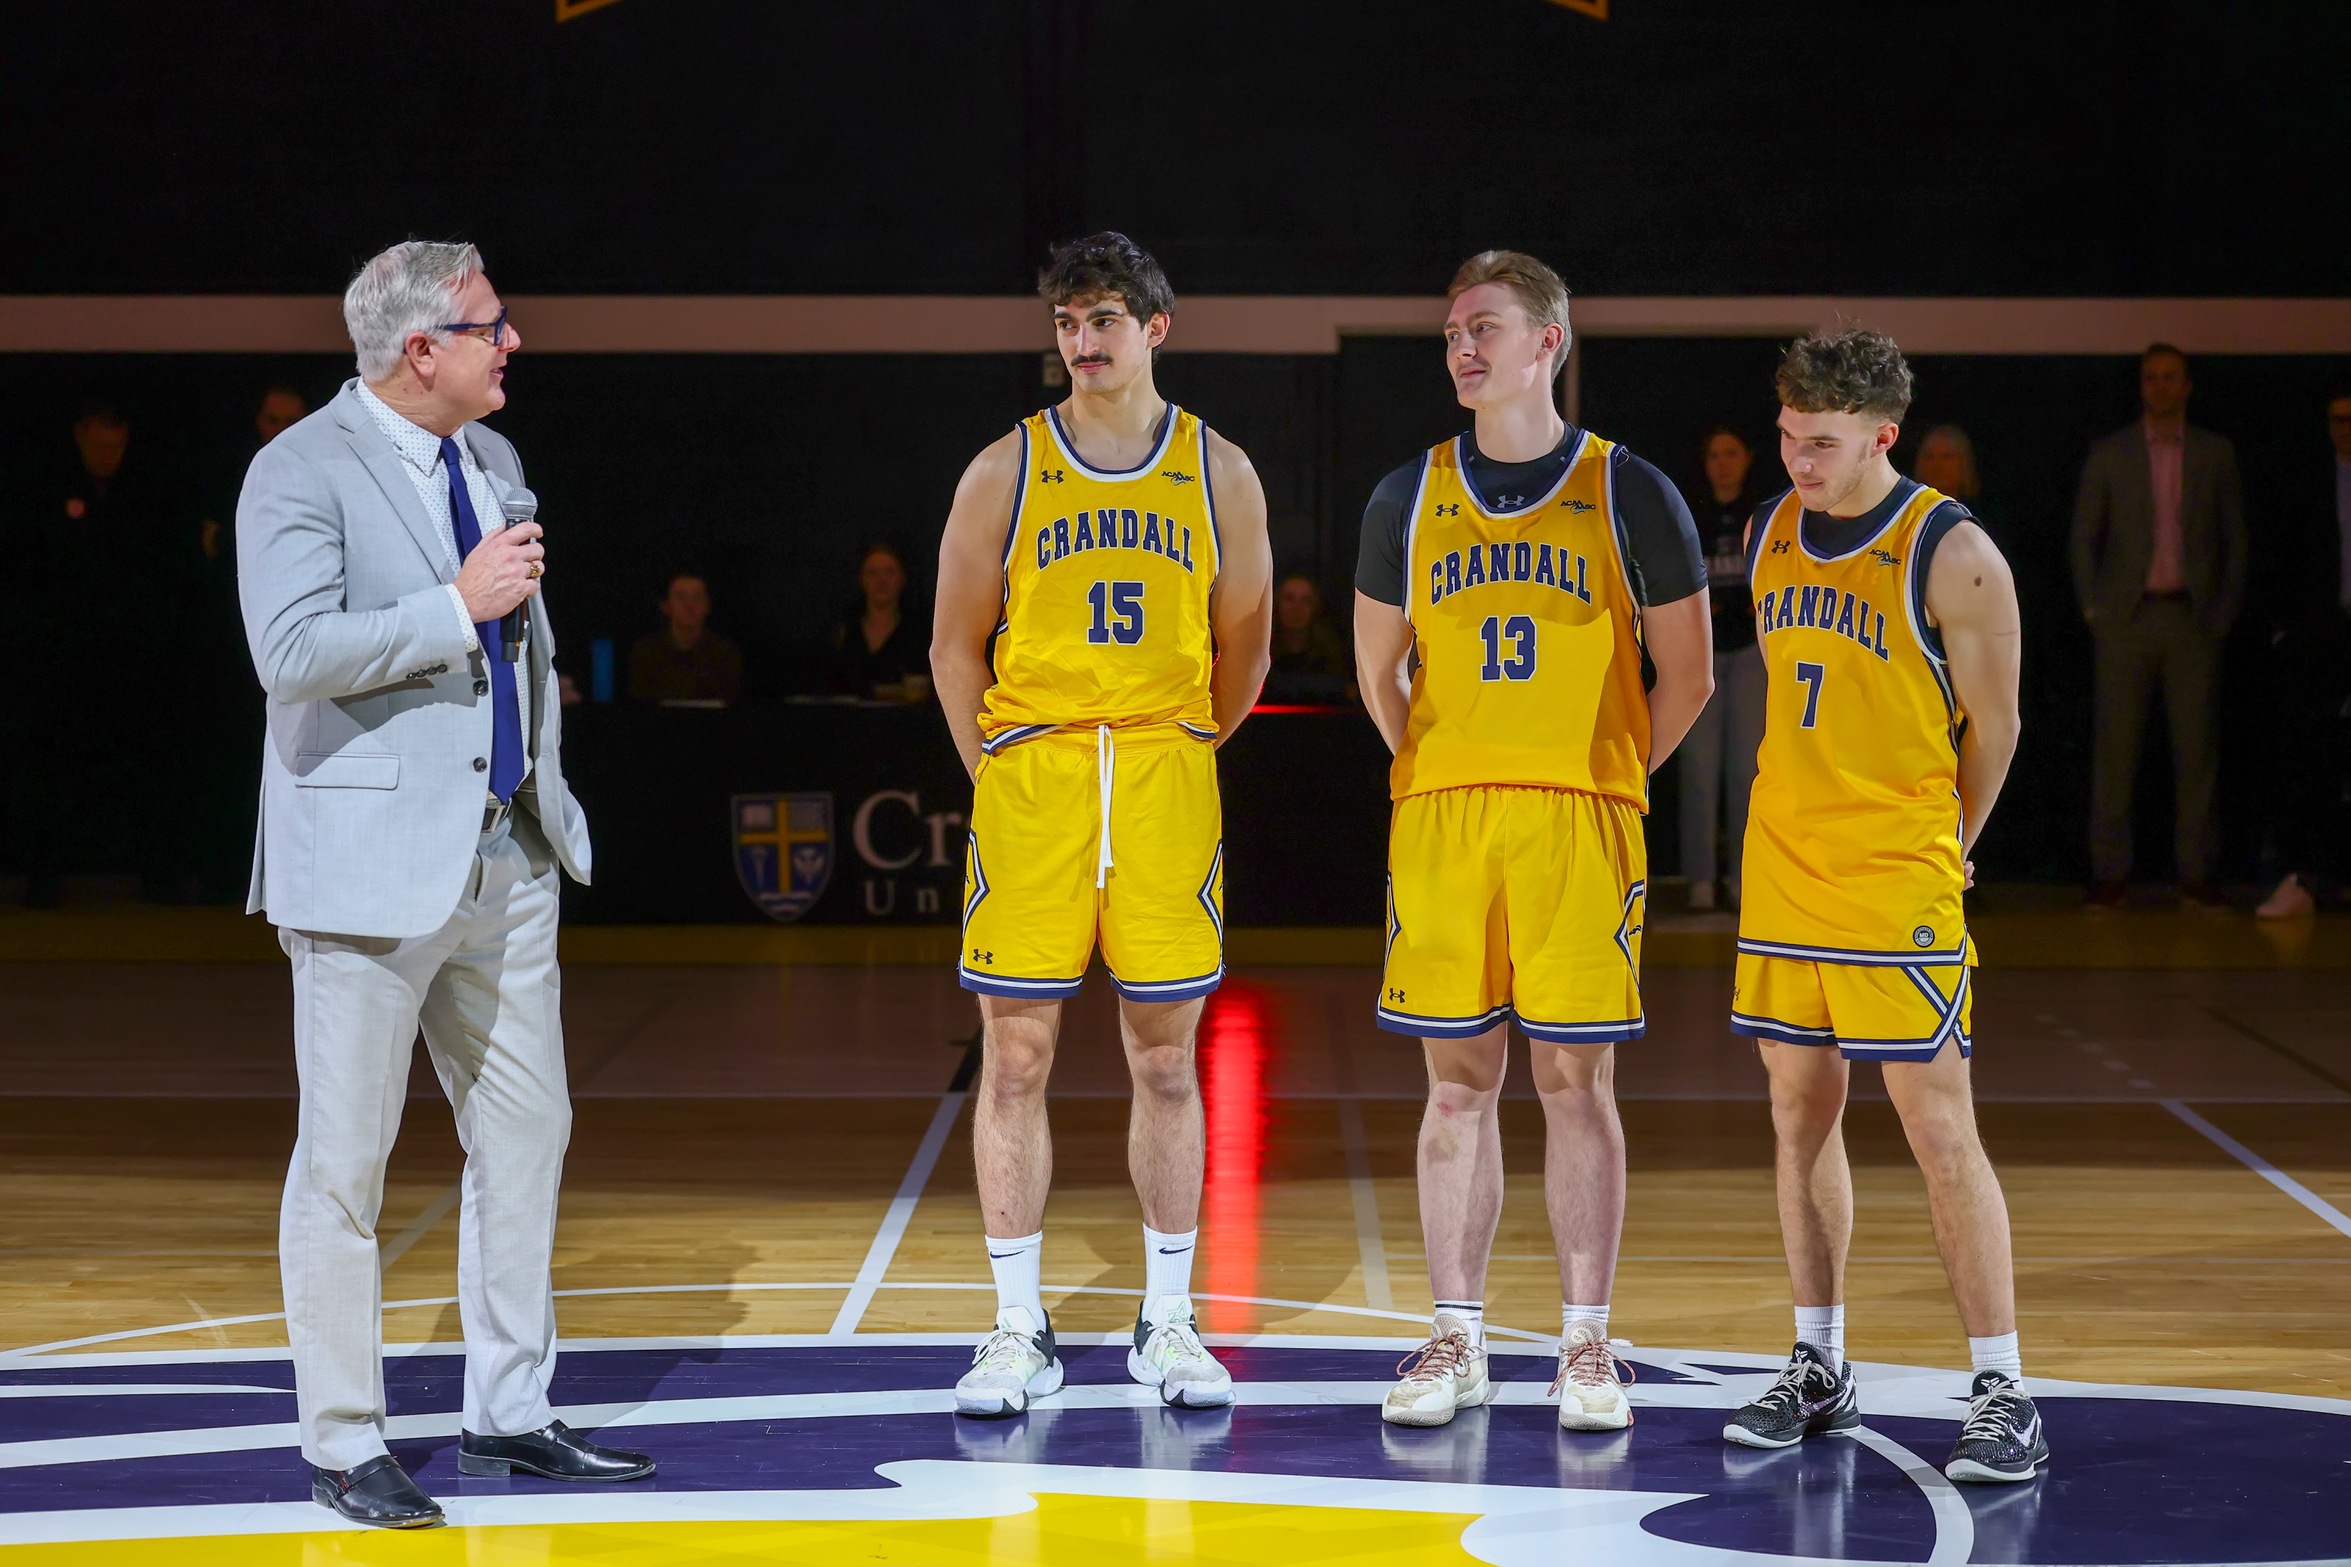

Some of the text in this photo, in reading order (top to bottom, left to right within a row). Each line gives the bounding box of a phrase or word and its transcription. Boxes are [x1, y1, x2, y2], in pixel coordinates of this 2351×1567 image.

[1036, 508, 1195, 576] CRANDALL
[1430, 541, 1592, 607] CRANDALL
[1087, 580, 1145, 646] 15
[1479, 613, 1538, 682] 13
[1795, 660, 1826, 730] 7
